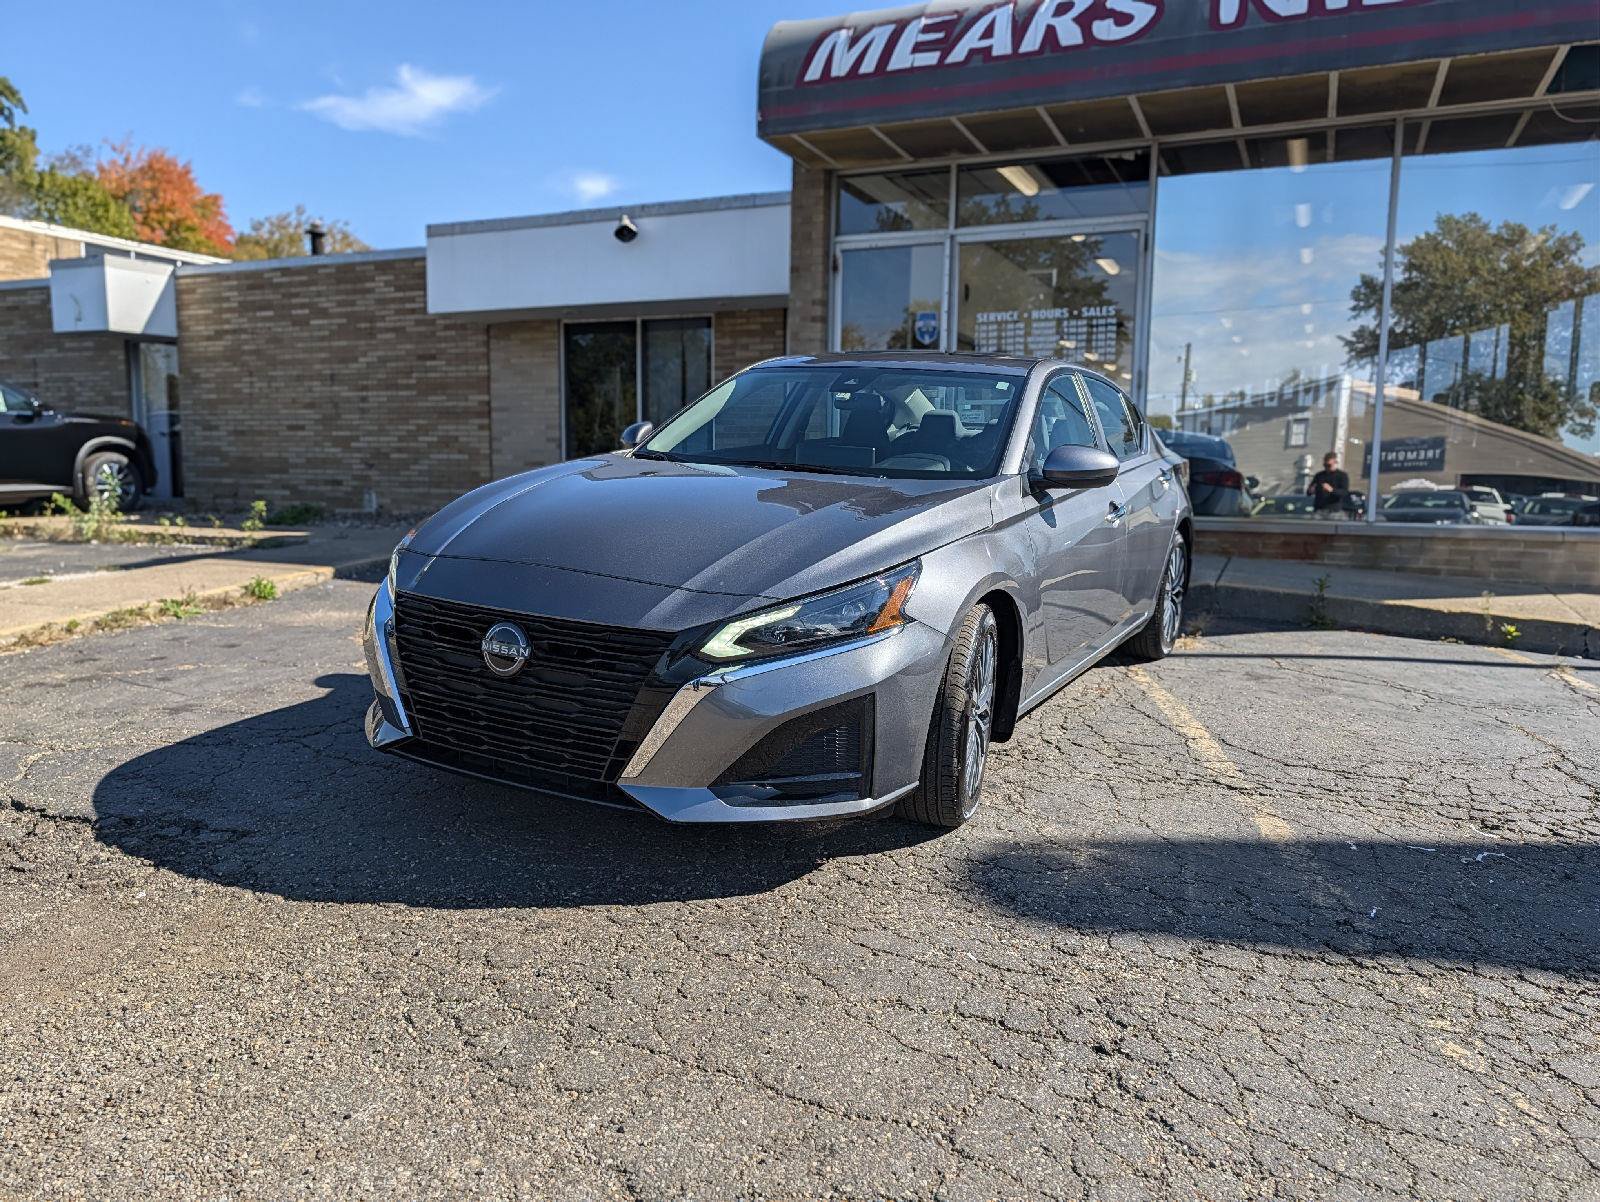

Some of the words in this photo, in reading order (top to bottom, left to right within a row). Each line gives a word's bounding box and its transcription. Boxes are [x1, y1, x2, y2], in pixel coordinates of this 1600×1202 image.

[803, 0, 1157, 82] MEARS
[976, 311, 1019, 322] SERVICE
[1031, 308, 1069, 320] HOURS
[1081, 305, 1117, 317] SALES
[482, 640, 529, 656] NISSAN
